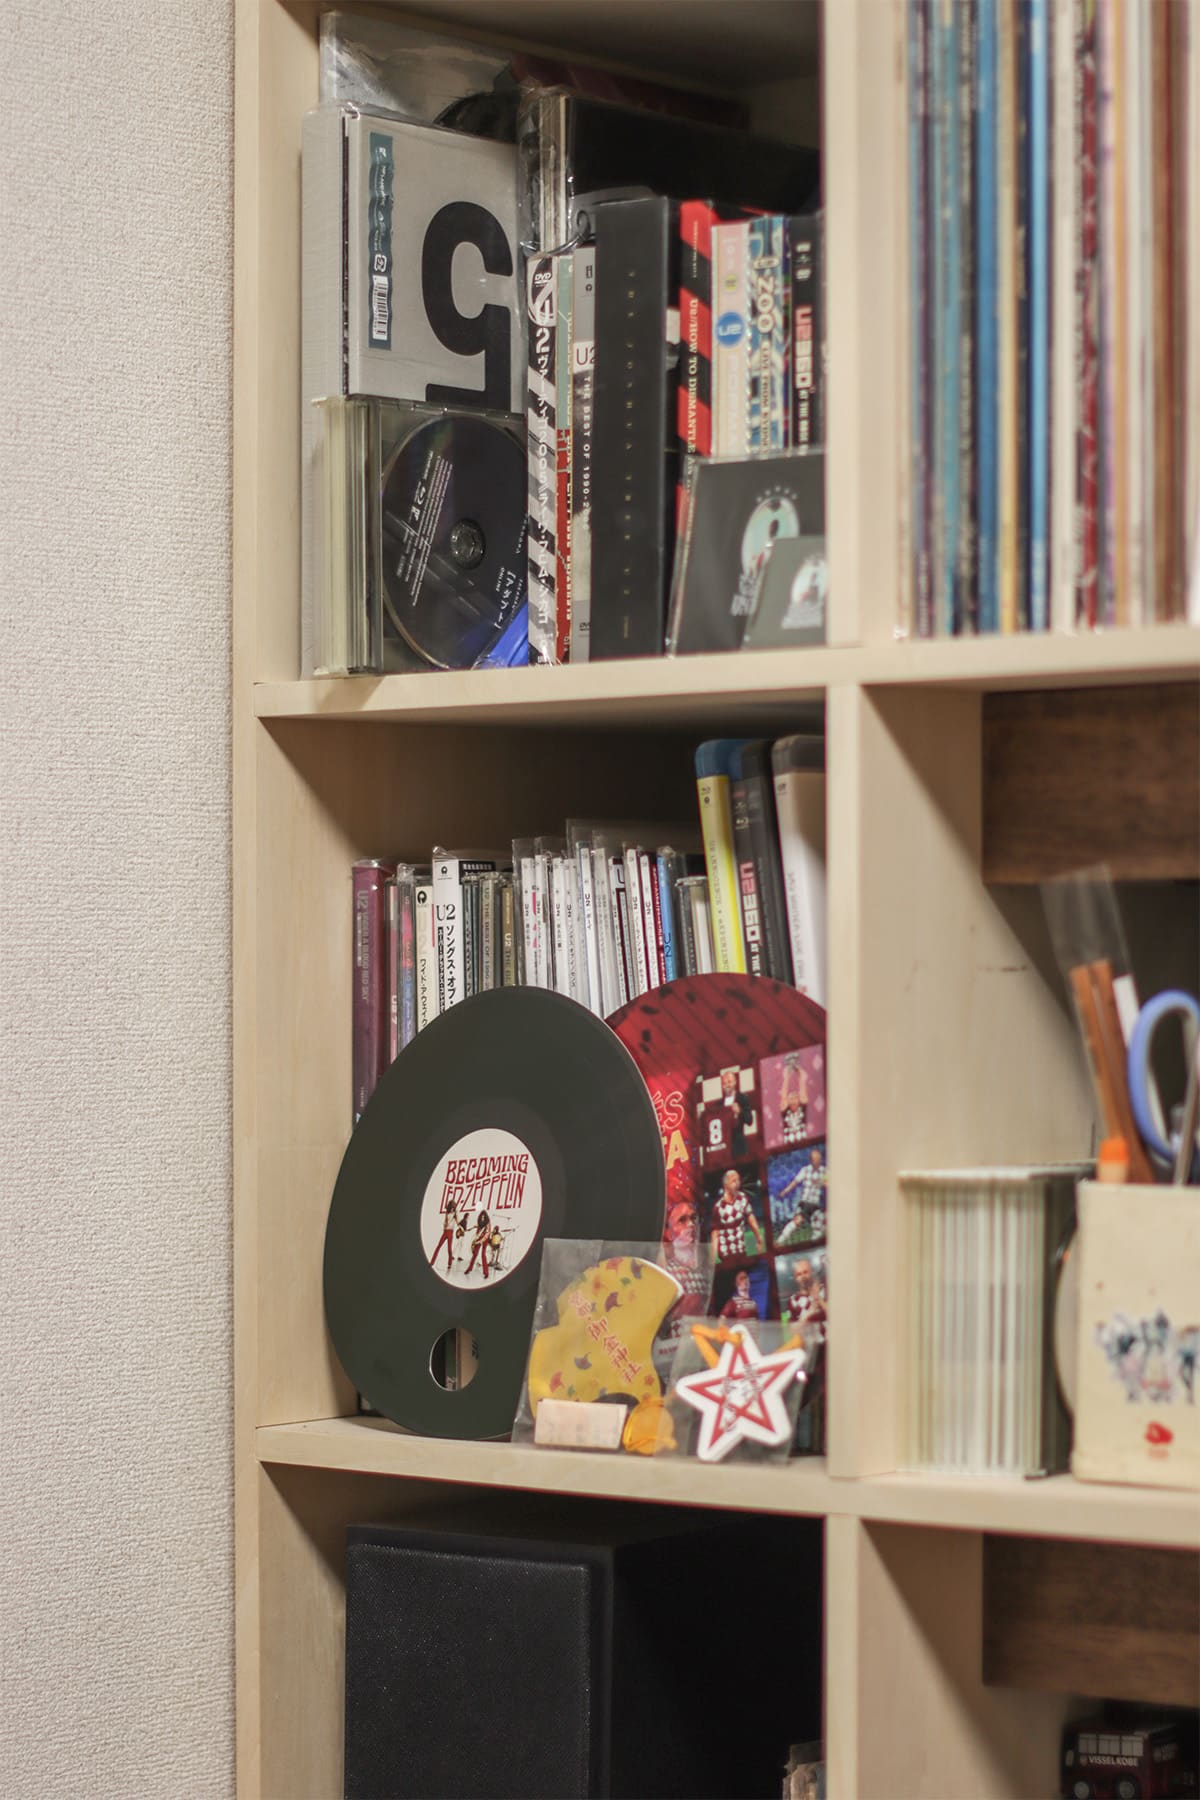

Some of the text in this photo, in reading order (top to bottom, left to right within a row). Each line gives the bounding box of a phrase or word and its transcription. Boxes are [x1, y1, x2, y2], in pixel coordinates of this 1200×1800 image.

[689, 357, 697, 374] TO
[687, 378, 697, 453] DISMANTLE
[584, 441, 591, 450] OF
[357, 890, 369, 909] U2
[436, 903, 456, 921] U2
[505, 932, 512, 947] U2
[483, 946, 490, 957] OF
[709, 1118, 723, 1144] 8
[445, 1153, 529, 1185] BECOMING
